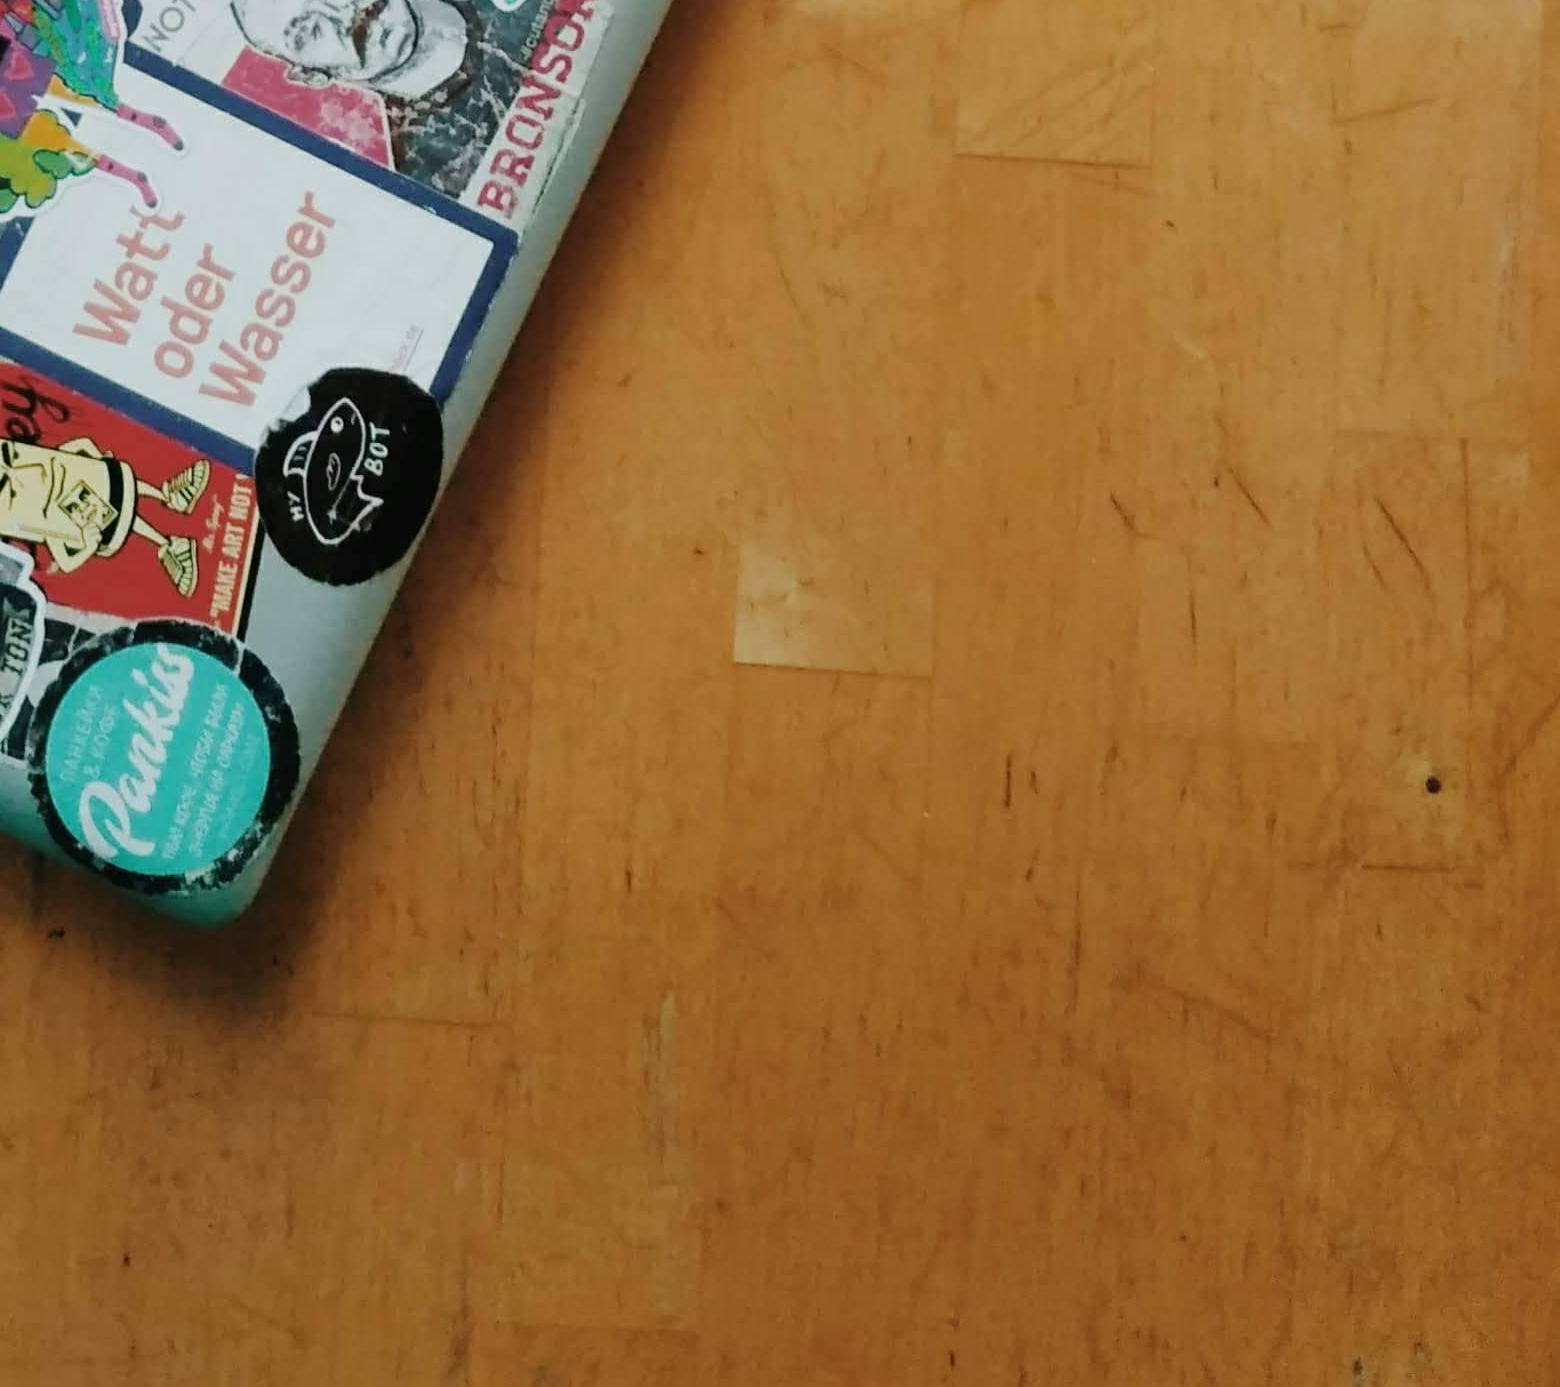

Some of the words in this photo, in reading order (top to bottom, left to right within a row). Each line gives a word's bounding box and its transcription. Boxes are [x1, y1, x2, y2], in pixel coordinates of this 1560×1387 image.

[72, 201, 185, 348] Watt
[153, 242, 237, 380] oder
[199, 192, 336, 408] Wasser
[364, 423, 389, 475] BOT
[222, 523, 244, 559] ART
[229, 484, 251, 520] NOT
[0, 621, 31, 675] TON
[76, 645, 195, 860] Pankiss
